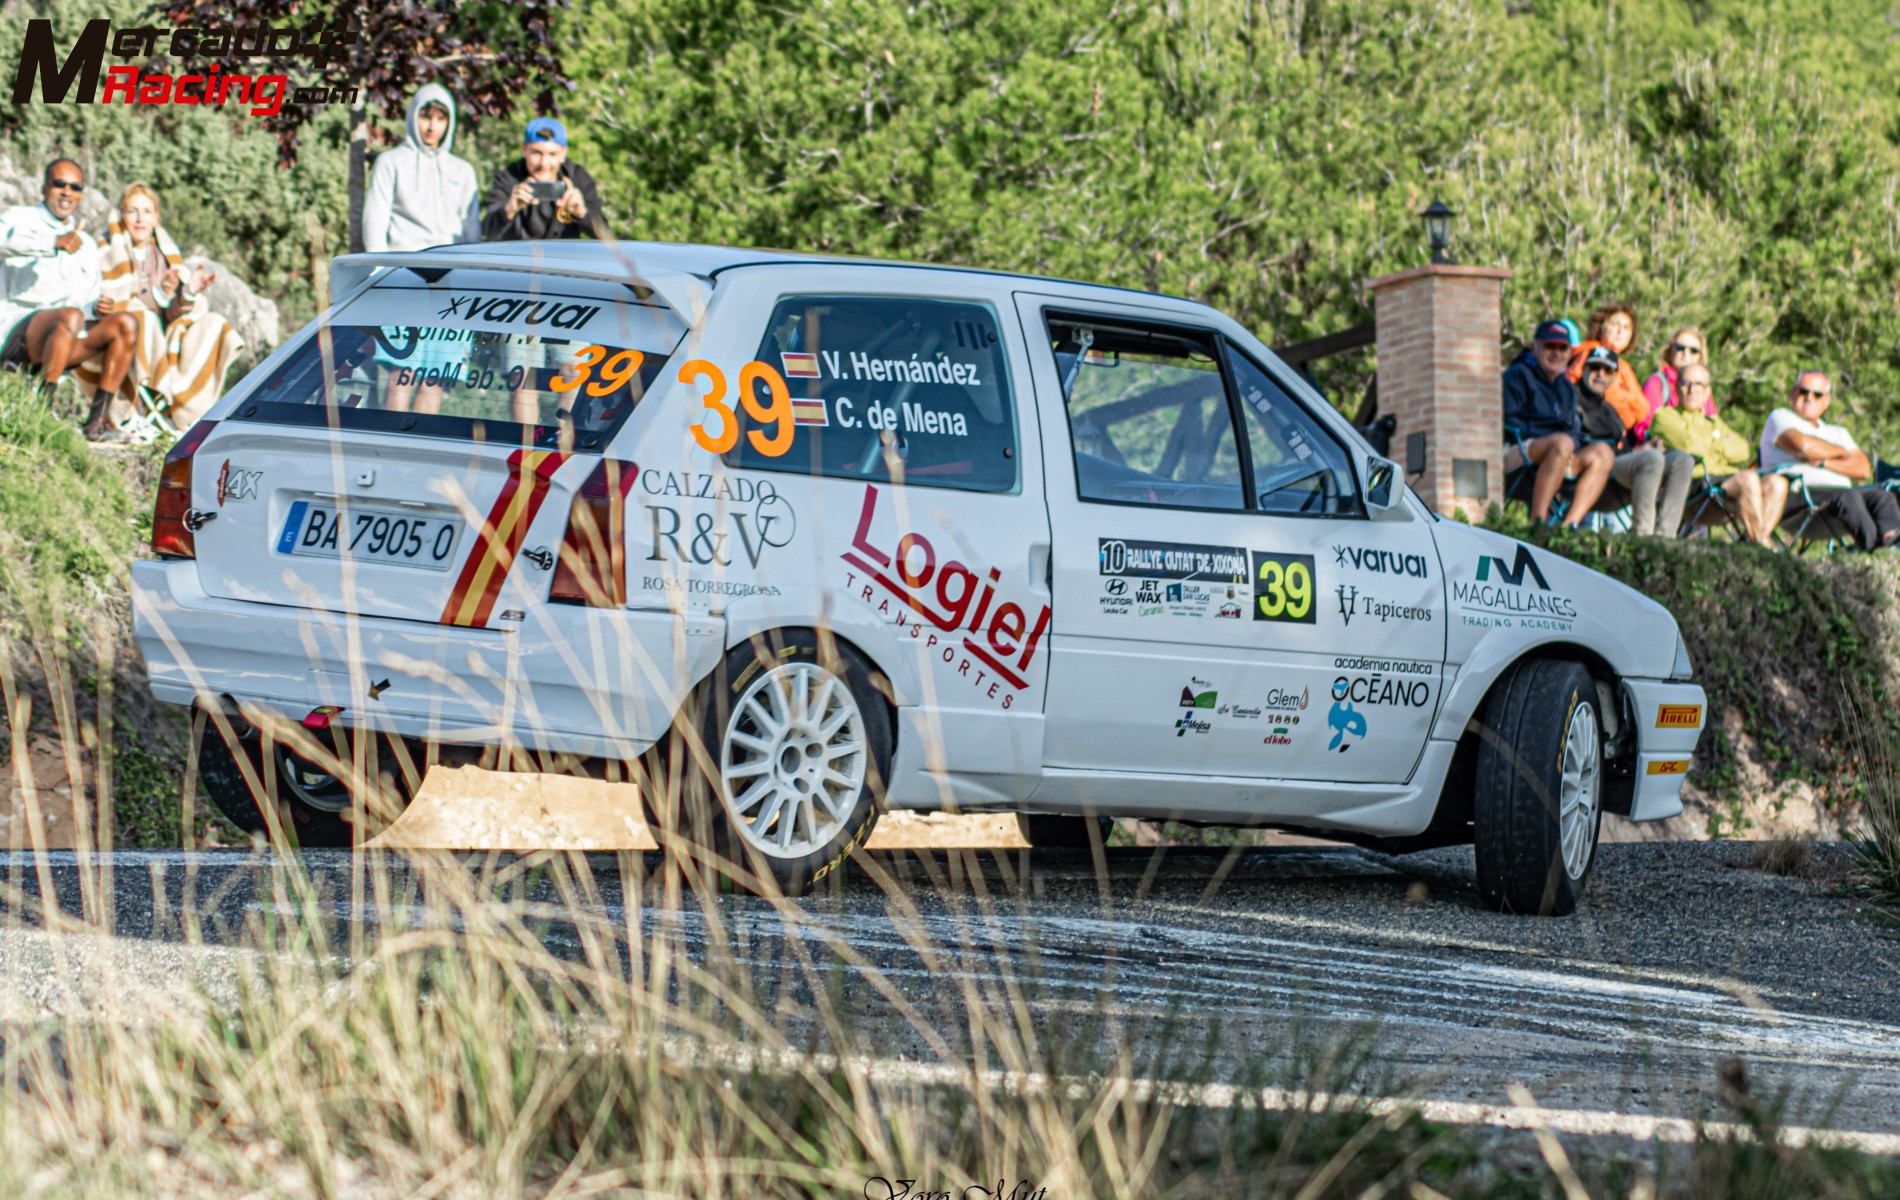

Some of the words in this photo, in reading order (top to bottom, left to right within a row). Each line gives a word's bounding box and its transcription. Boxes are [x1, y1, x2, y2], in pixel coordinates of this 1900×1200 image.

[549, 344, 644, 397] 39
[822, 351, 848, 380] V.
[850, 352, 981, 386] Hernández
[678, 359, 795, 457] 39
[835, 397, 862, 429] C.
[867, 400, 898, 431] de
[902, 402, 968, 436] Mena
[642, 469, 776, 505] CALZADO
[302, 510, 341, 550] BA
[347, 512, 426, 558] 7905
[1101, 540, 1126, 574] 10
[1127, 549, 1163, 570] RALLYE
[1212, 554, 1246, 576] XIXONA
[642, 576, 682, 592] ROSA
[686, 579, 782, 596] TORREGROSA
[852, 483, 1052, 672] Logiel
[1140, 580, 1159, 591] JET
[1183, 585, 1200, 593] TALLER
[1259, 560, 1312, 618] 39
[1135, 591, 1161, 604] WAX
[1363, 597, 1432, 622] Tapiceros
[1453, 580, 1577, 618] MAGALLANES
[845, 572, 1014, 710] TRANSPORTES
[1462, 616, 1512, 628] TRADING
[1520, 619, 1573, 632] ACADEMY
[1334, 656, 1390, 672] academia
[1392, 660, 1432, 674] nautica
[1660, 707, 1698, 723] PIRELLI
